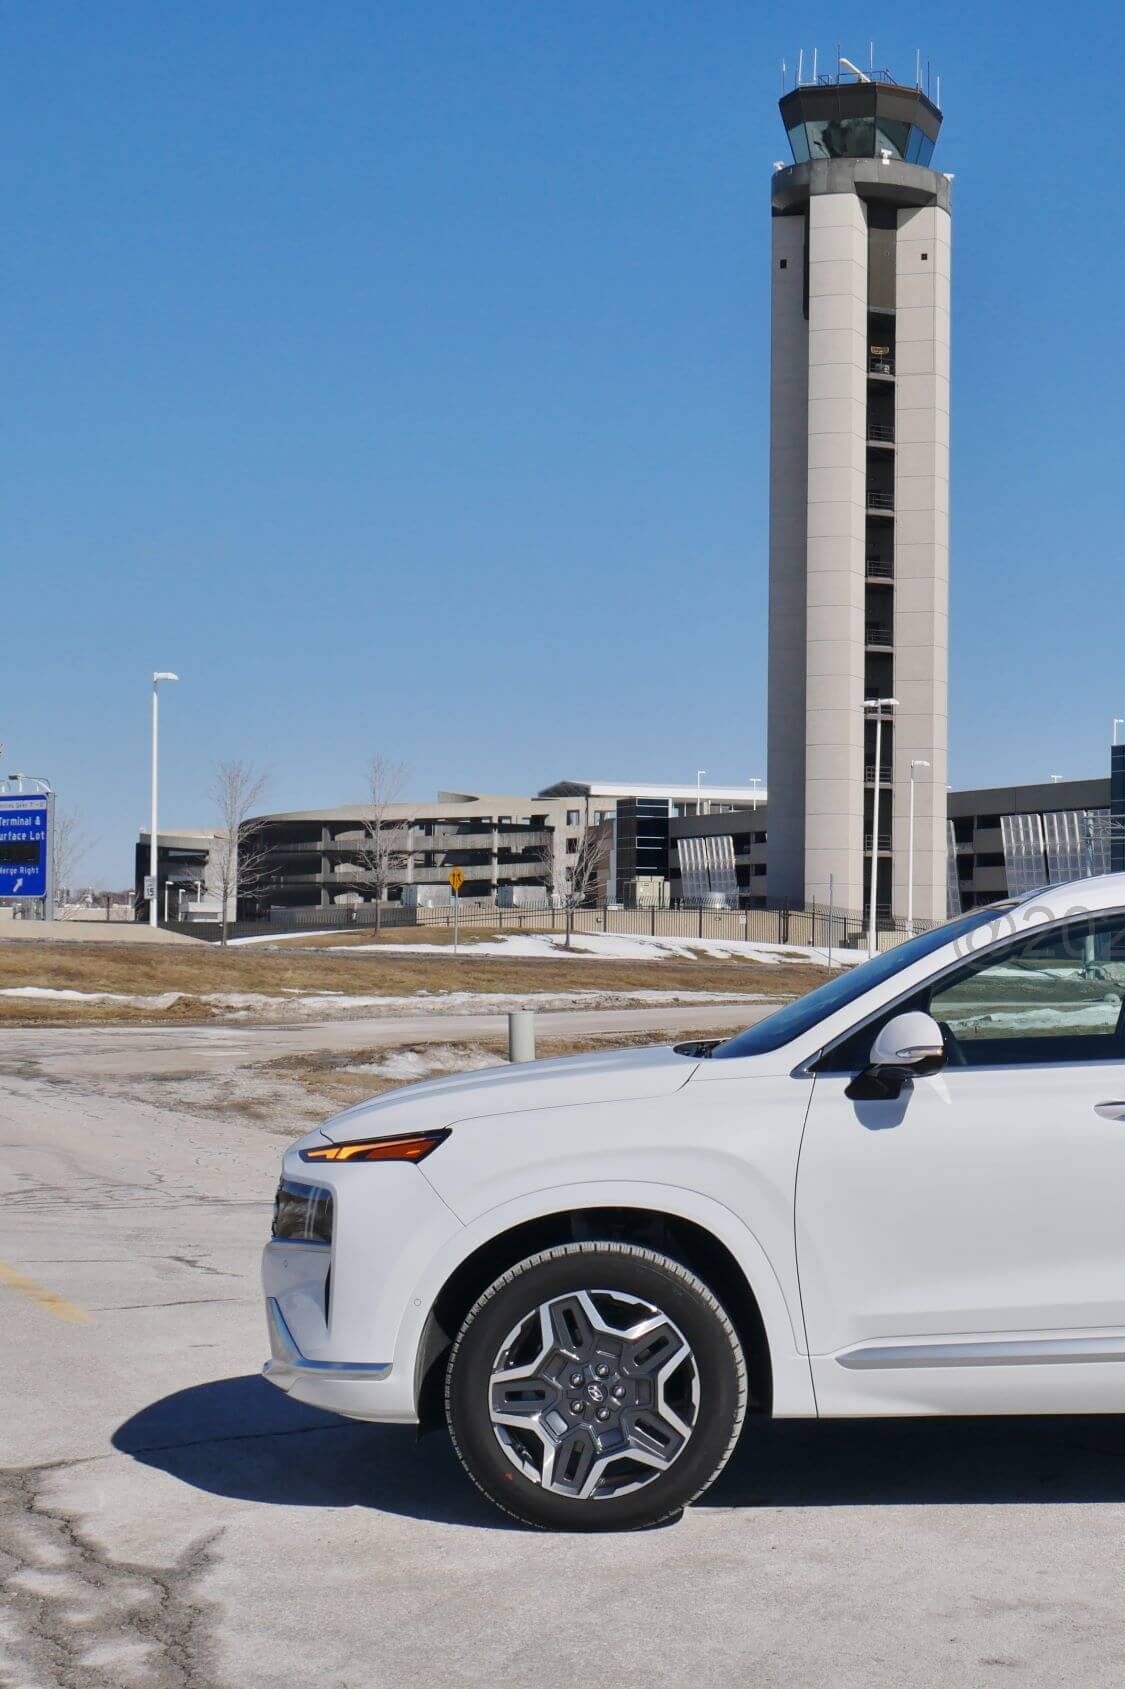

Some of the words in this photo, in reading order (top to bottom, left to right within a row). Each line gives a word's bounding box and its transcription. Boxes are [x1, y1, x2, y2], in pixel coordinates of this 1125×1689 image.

[0, 831, 27, 841] urface
[29, 830, 45, 841] Lot
[20, 866, 39, 877] Right
